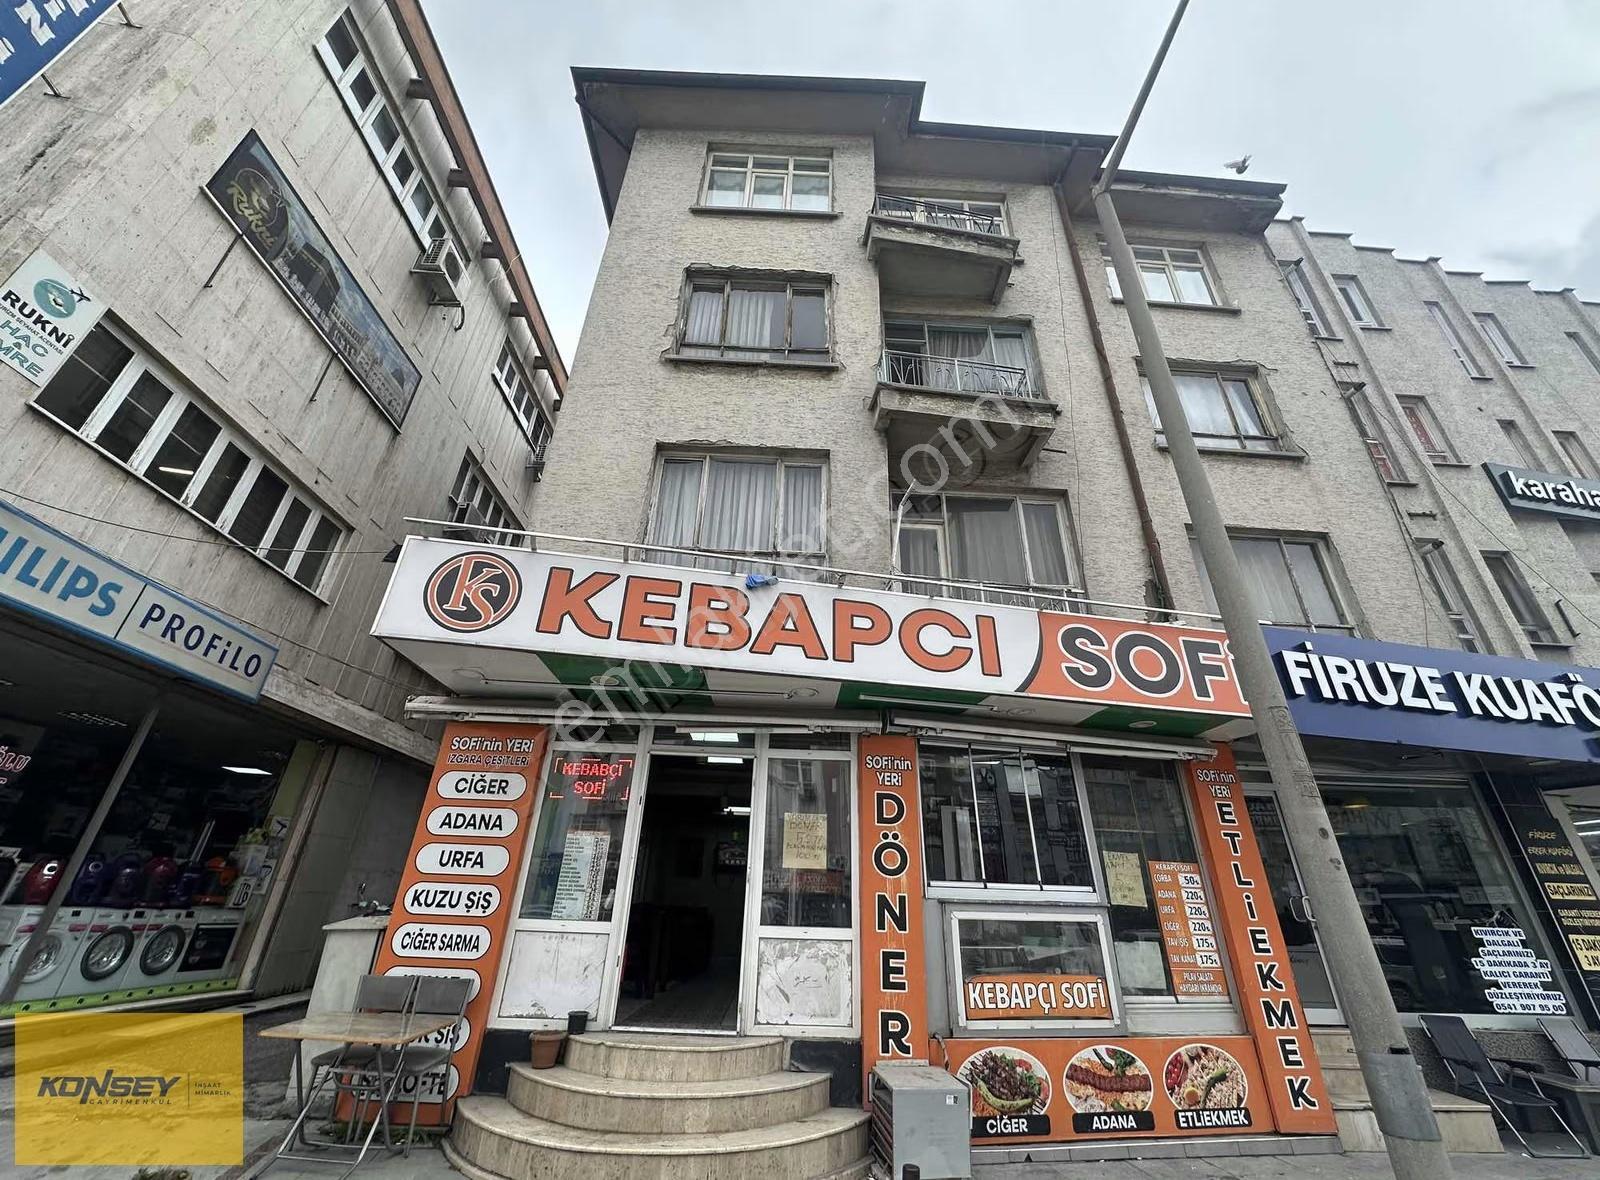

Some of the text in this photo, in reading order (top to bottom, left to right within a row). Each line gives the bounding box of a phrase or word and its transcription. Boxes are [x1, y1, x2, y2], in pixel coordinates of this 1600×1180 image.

[0, 319, 49, 357] HAC
[139, 603, 262, 677] PROFiLO
[535, 566, 1250, 706] KEBAPCI SOF
[1281, 641, 1457, 712] FİRUZE
[455, 774, 509, 796] CİĞER
[573, 779, 607, 795] SOFİ
[439, 812, 503, 832] ADANA
[438, 850, 485, 869] URFA
[410, 889, 463, 909] KUZU
[872, 790, 913, 1057] DÖNER
[1473, 929, 1511, 937] KIVIRCIK
[438, 934, 480, 953] SARMA
[1486, 939, 1520, 947] DALGALI
[1481, 949, 1534, 958] SAÇLARINIZI
[1482, 970, 1511, 978] KALICI
[1539, 961, 1550, 969] AY
[1500, 981, 1540, 990] VEREREK
[967, 978, 1107, 1014] KEBAPÇI SOFİ
[986, 1115, 1029, 1134] CİĞER
[1092, 1114, 1137, 1130] ADANA
